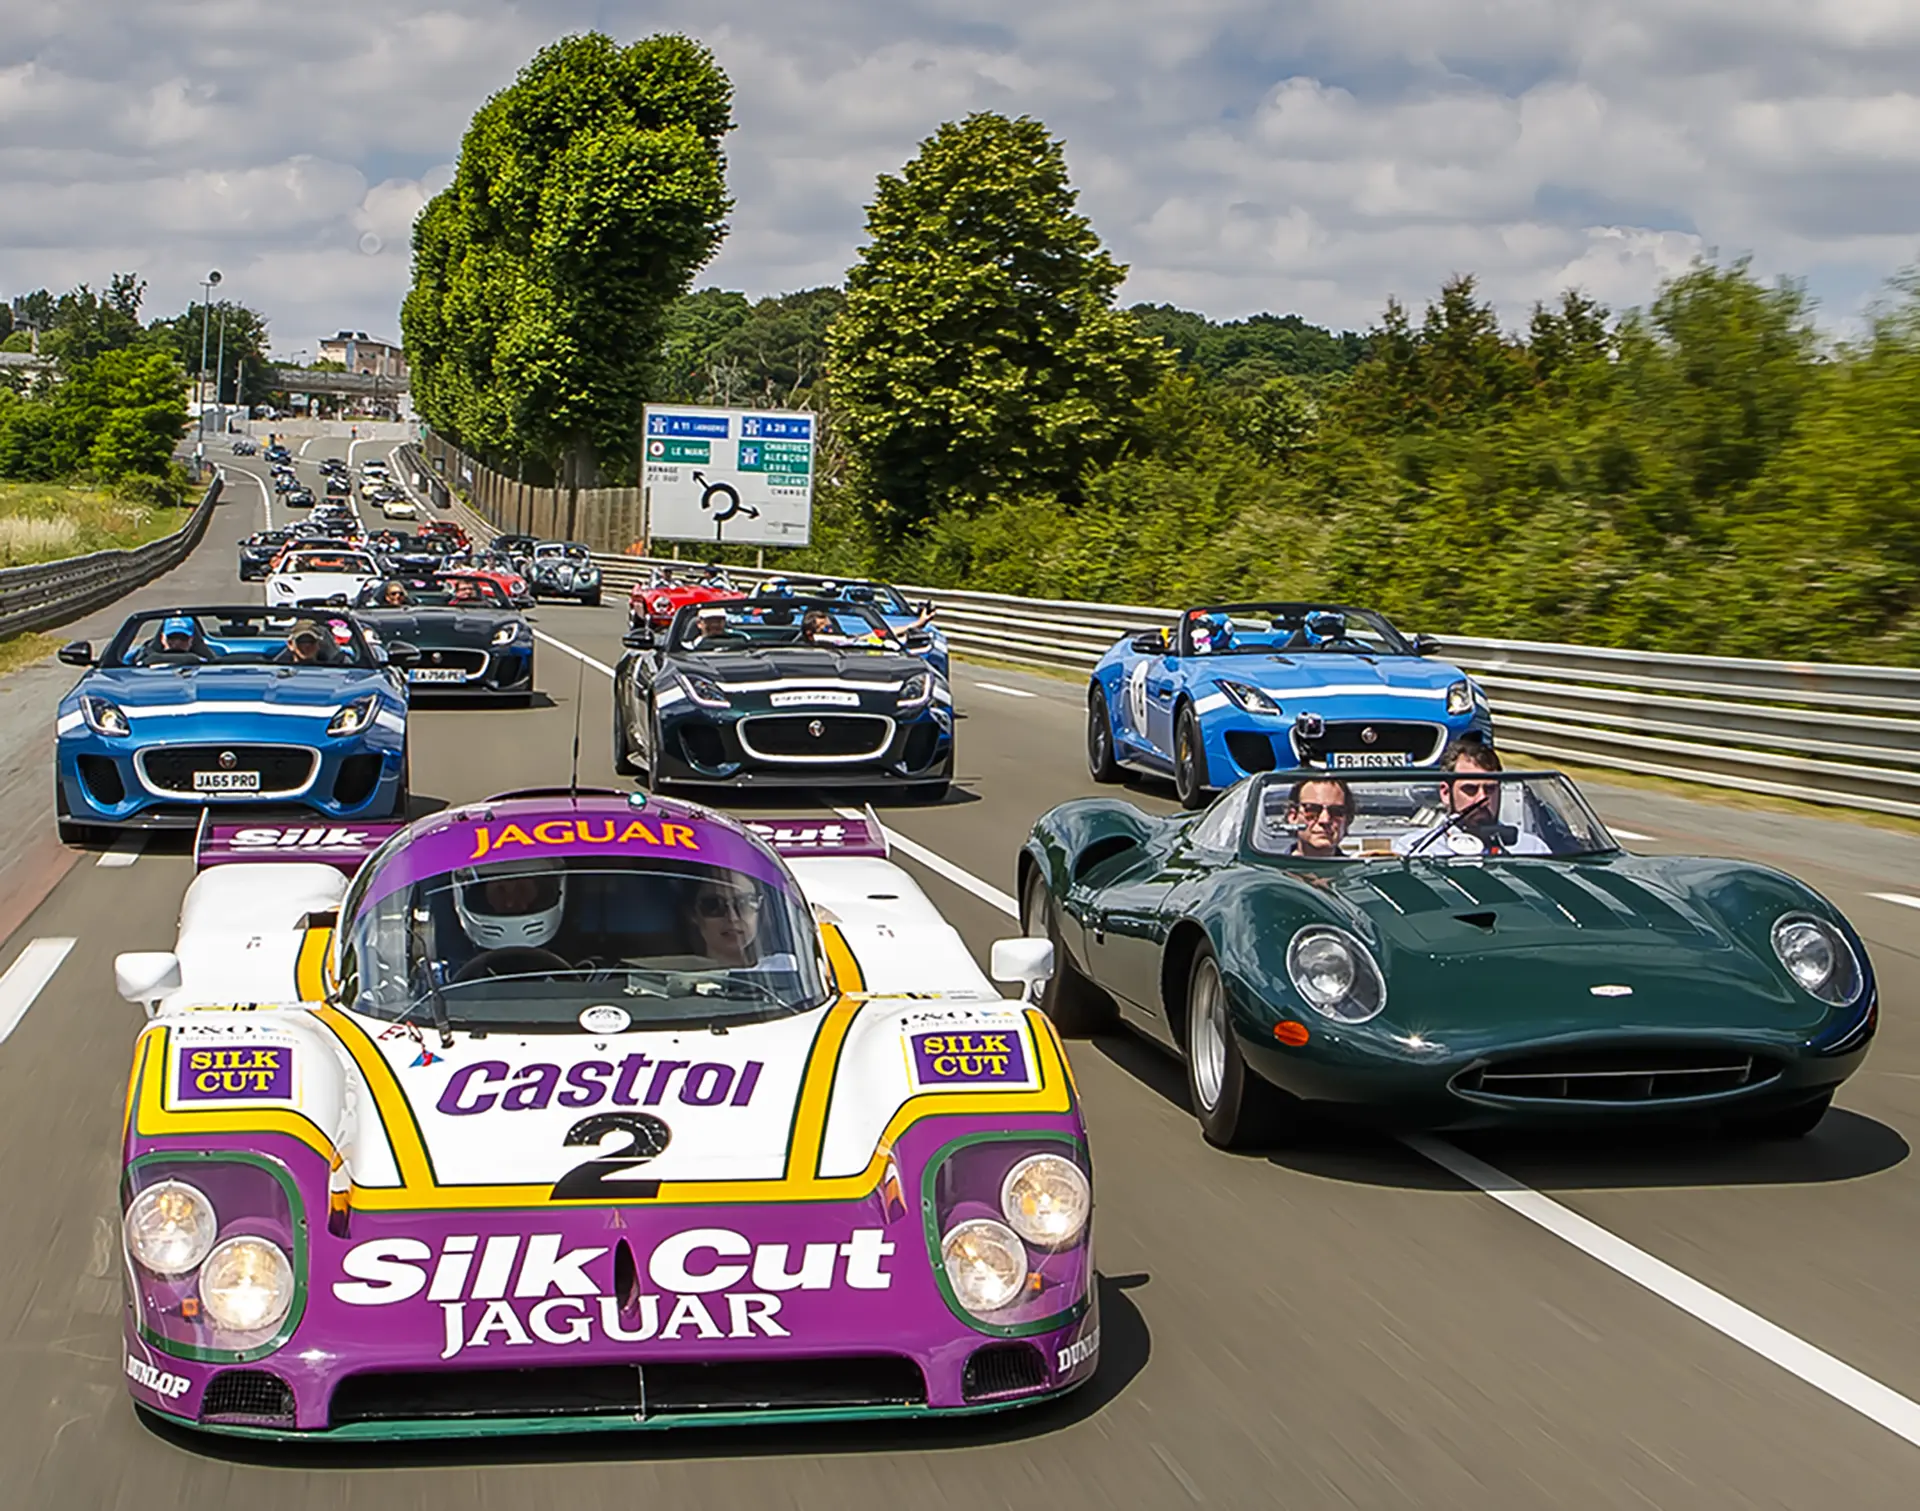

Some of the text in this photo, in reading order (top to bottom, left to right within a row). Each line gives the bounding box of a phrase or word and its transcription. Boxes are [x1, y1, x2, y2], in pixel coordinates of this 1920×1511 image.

[670, 447, 682, 456] LE
[762, 463, 792, 473] LAVAL
[231, 775, 258, 788] PRO
[228, 828, 369, 846] Silk
[469, 819, 700, 860] JAGUAR
[922, 1034, 1012, 1055] SILK
[190, 1050, 281, 1070] SILK
[932, 1054, 1009, 1076] CUT
[195, 1070, 275, 1093] CUT
[436, 1053, 764, 1115] Castrol
[550, 1112, 669, 1200] 2
[332, 1228, 896, 1305] Silk Cut
[440, 1293, 791, 1359] JAGUAR
